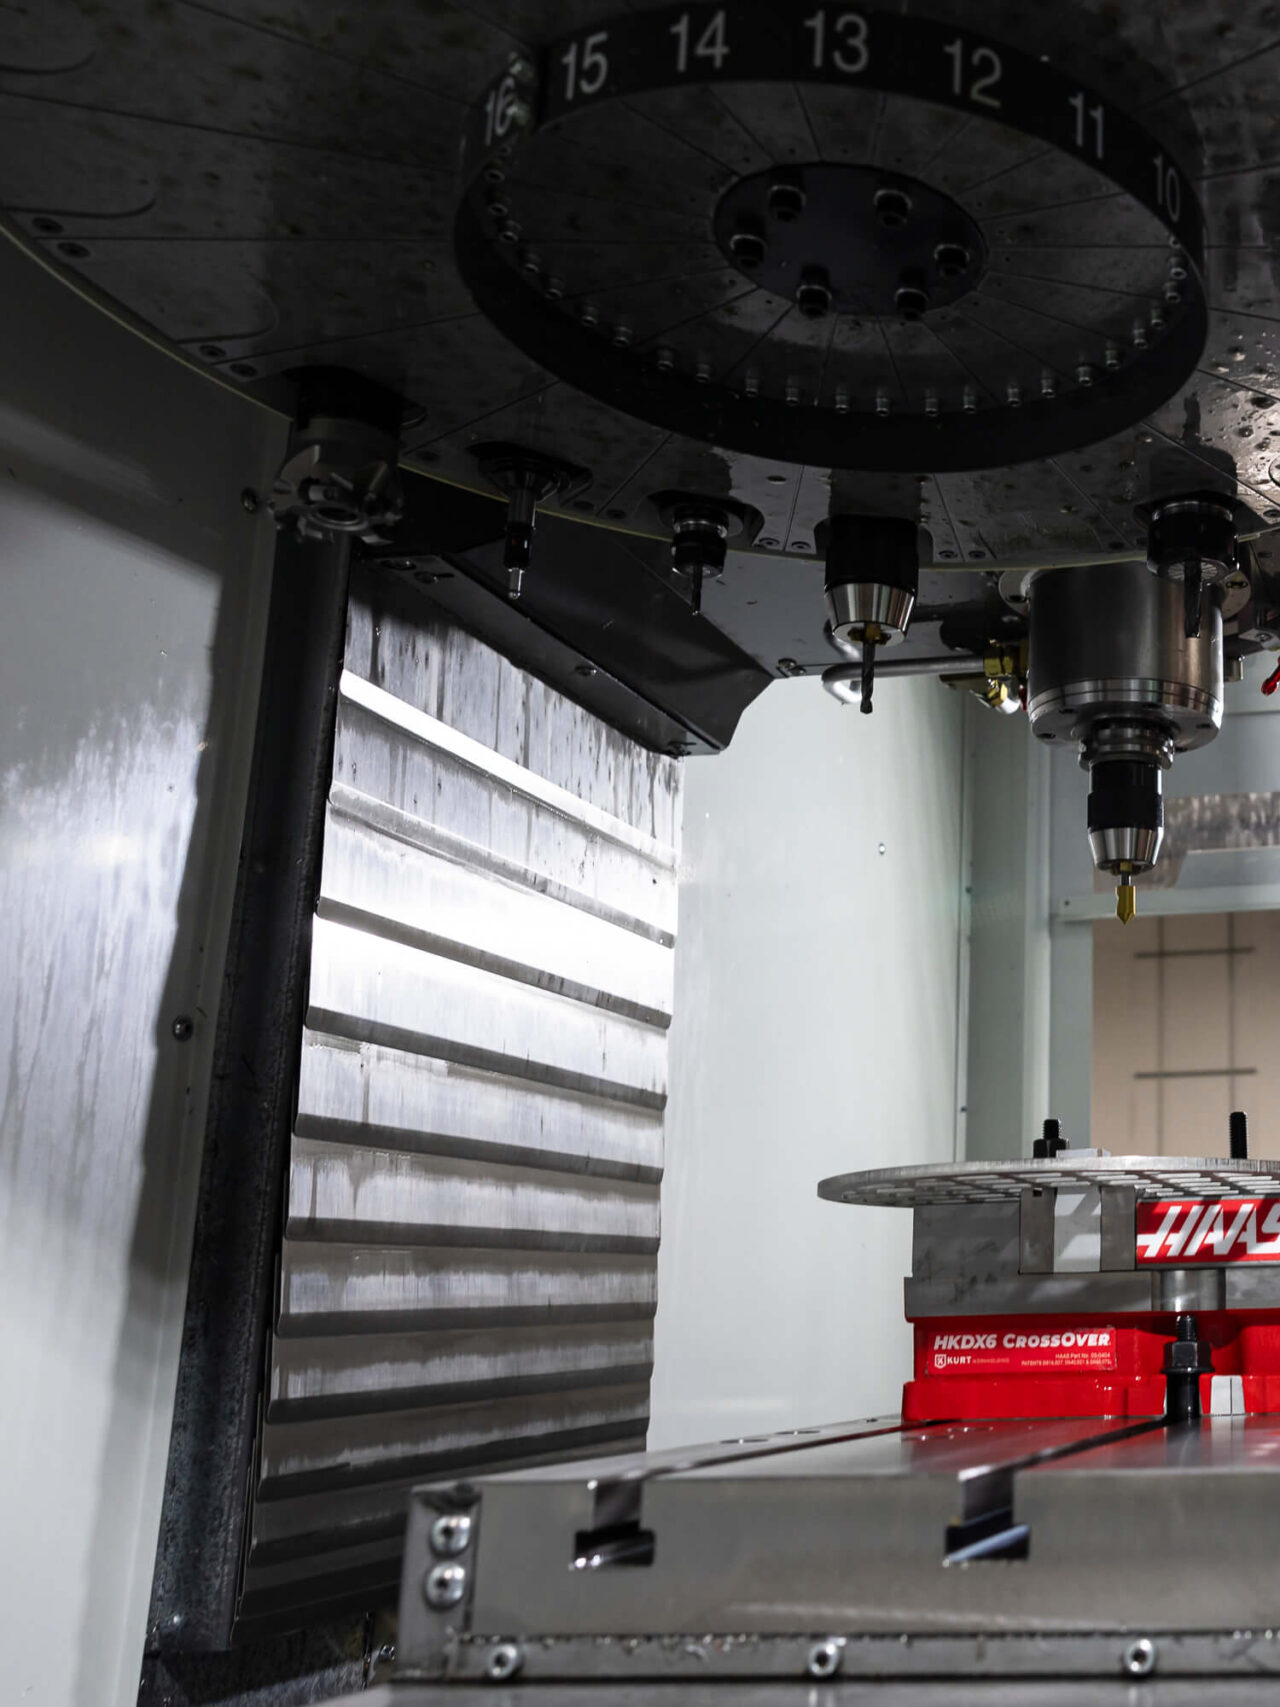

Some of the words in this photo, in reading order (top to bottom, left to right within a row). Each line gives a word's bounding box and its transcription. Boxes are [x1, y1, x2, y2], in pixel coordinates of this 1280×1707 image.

[561, 30, 609, 101] 15
[668, 8, 731, 74] 14
[803, 8, 871, 75] 13
[943, 37, 1003, 110] 12
[485, 75, 516, 147] 16
[1068, 91, 1104, 160] 11
[1153, 153, 1181, 223] 10
[933, 1333, 998, 1350] HKDX6
[946, 1355, 972, 1365] KURT
